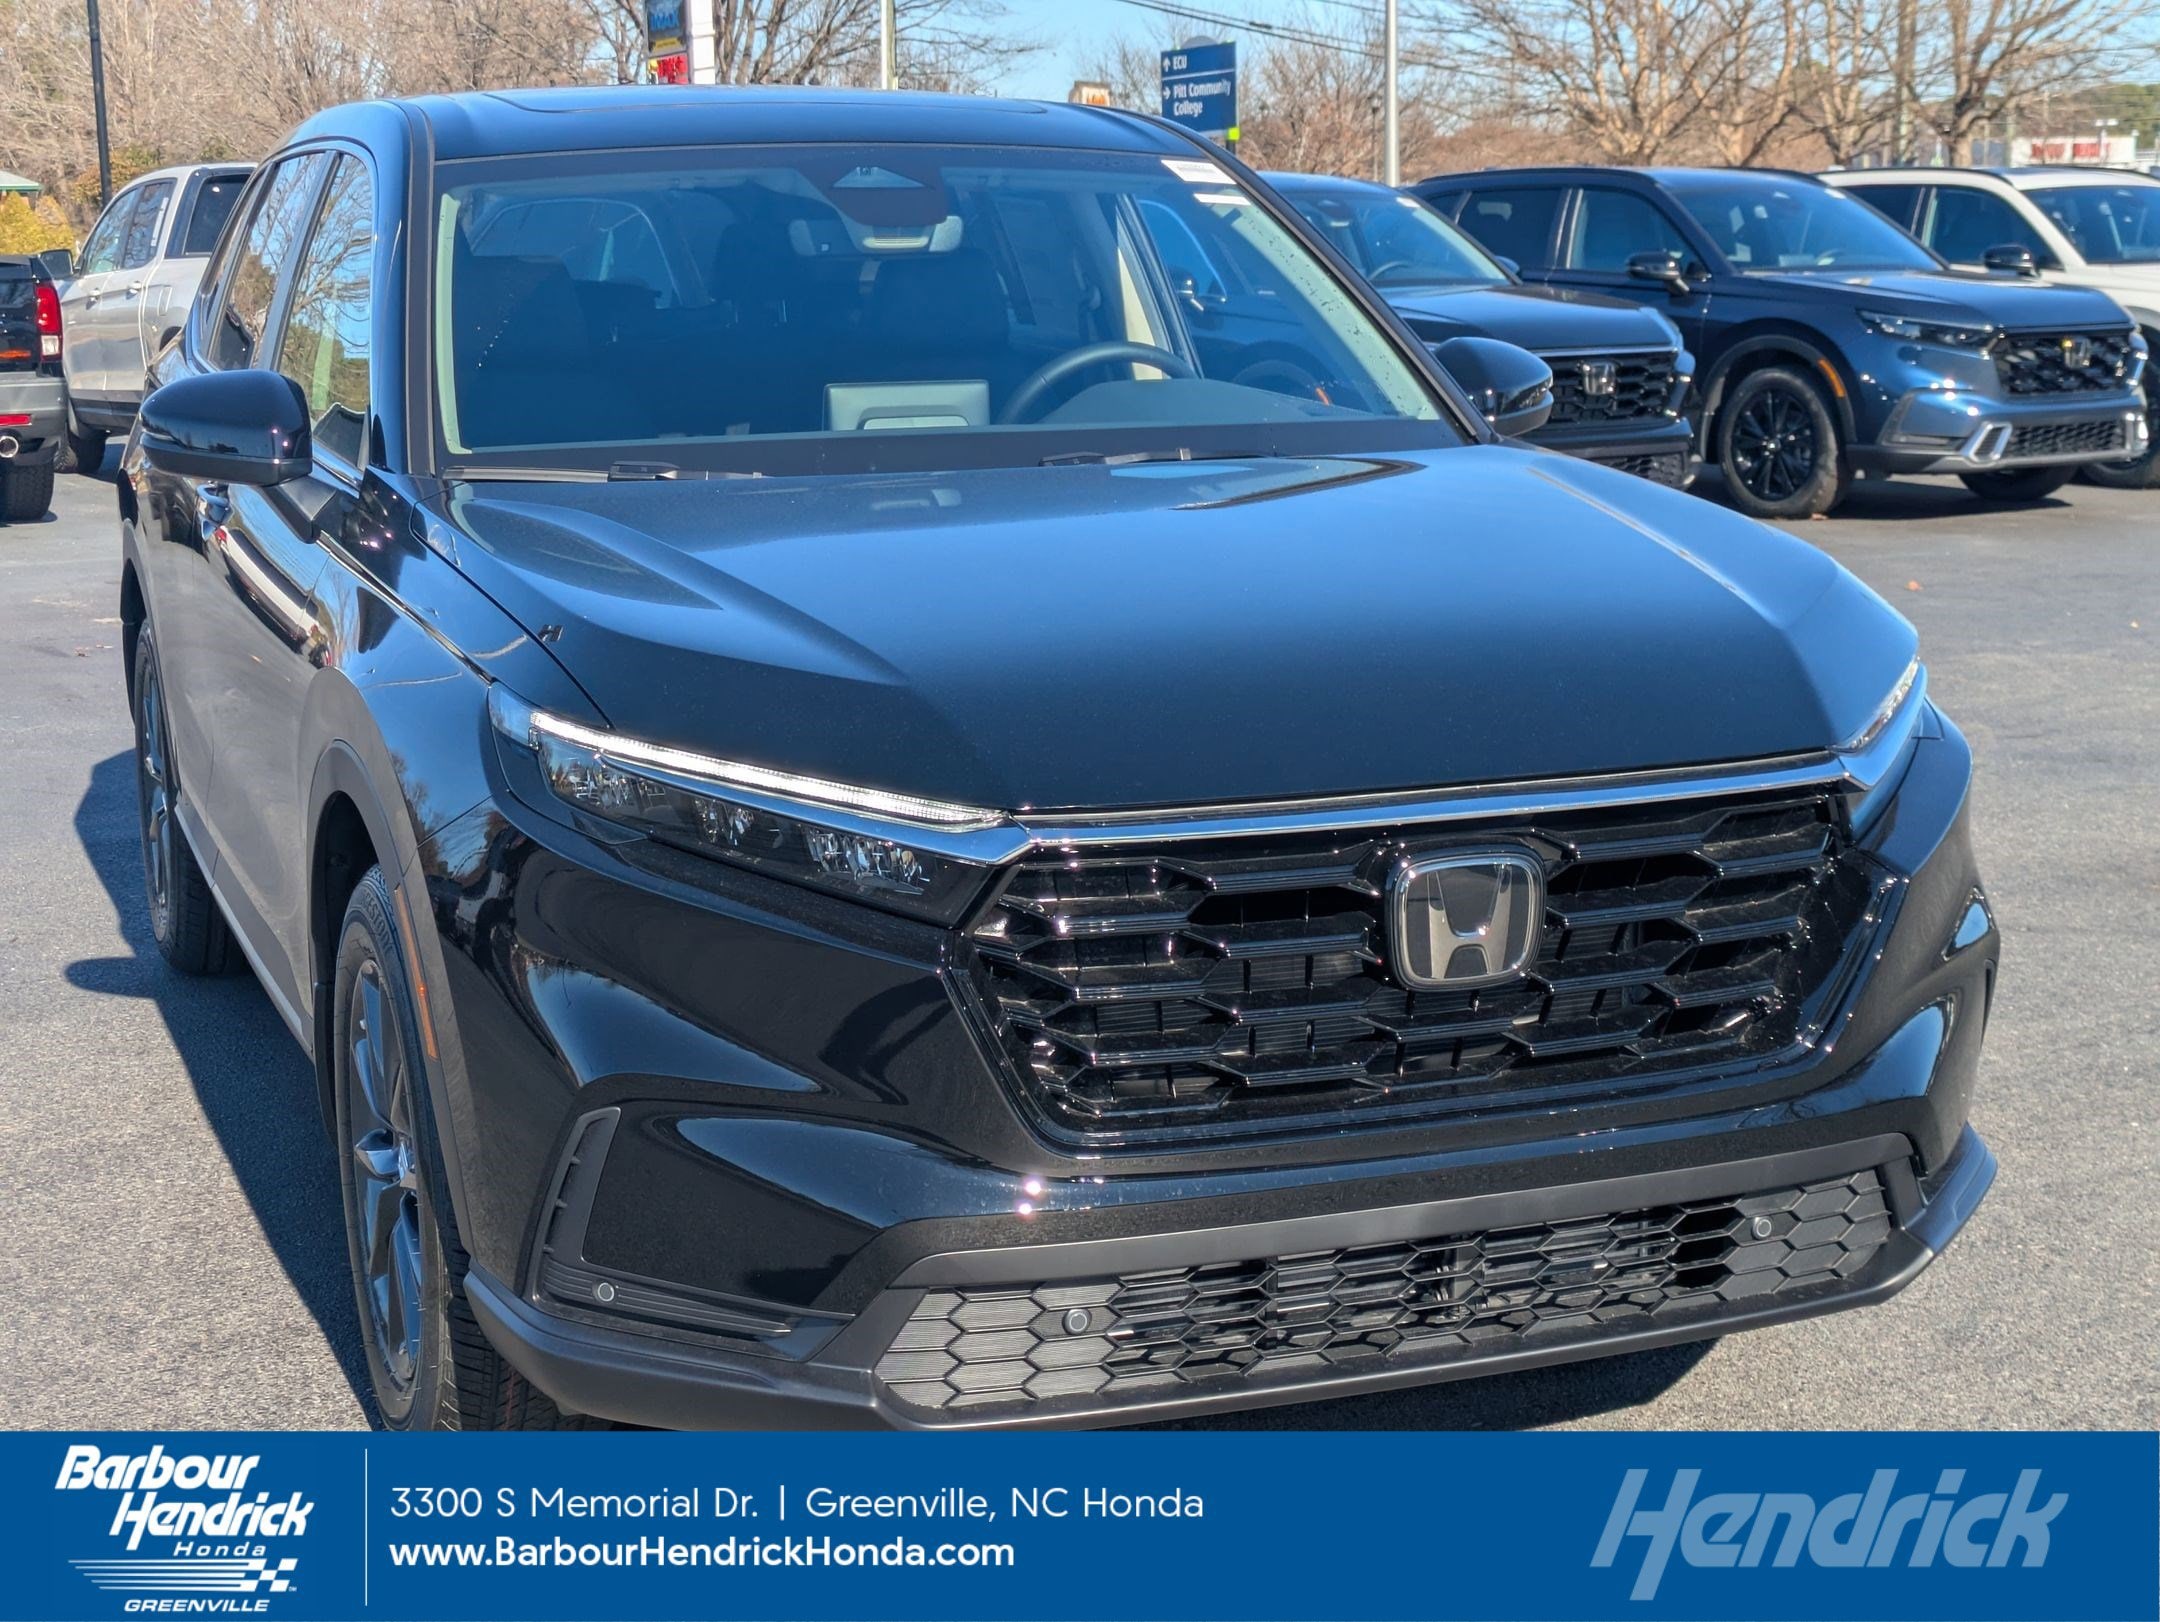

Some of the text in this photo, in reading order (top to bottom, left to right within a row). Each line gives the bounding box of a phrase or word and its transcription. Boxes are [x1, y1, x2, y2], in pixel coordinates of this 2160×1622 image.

[1173, 55, 1187, 70] ECU
[1173, 79, 1231, 98] Pitt Community
[1173, 100, 1203, 117] College
